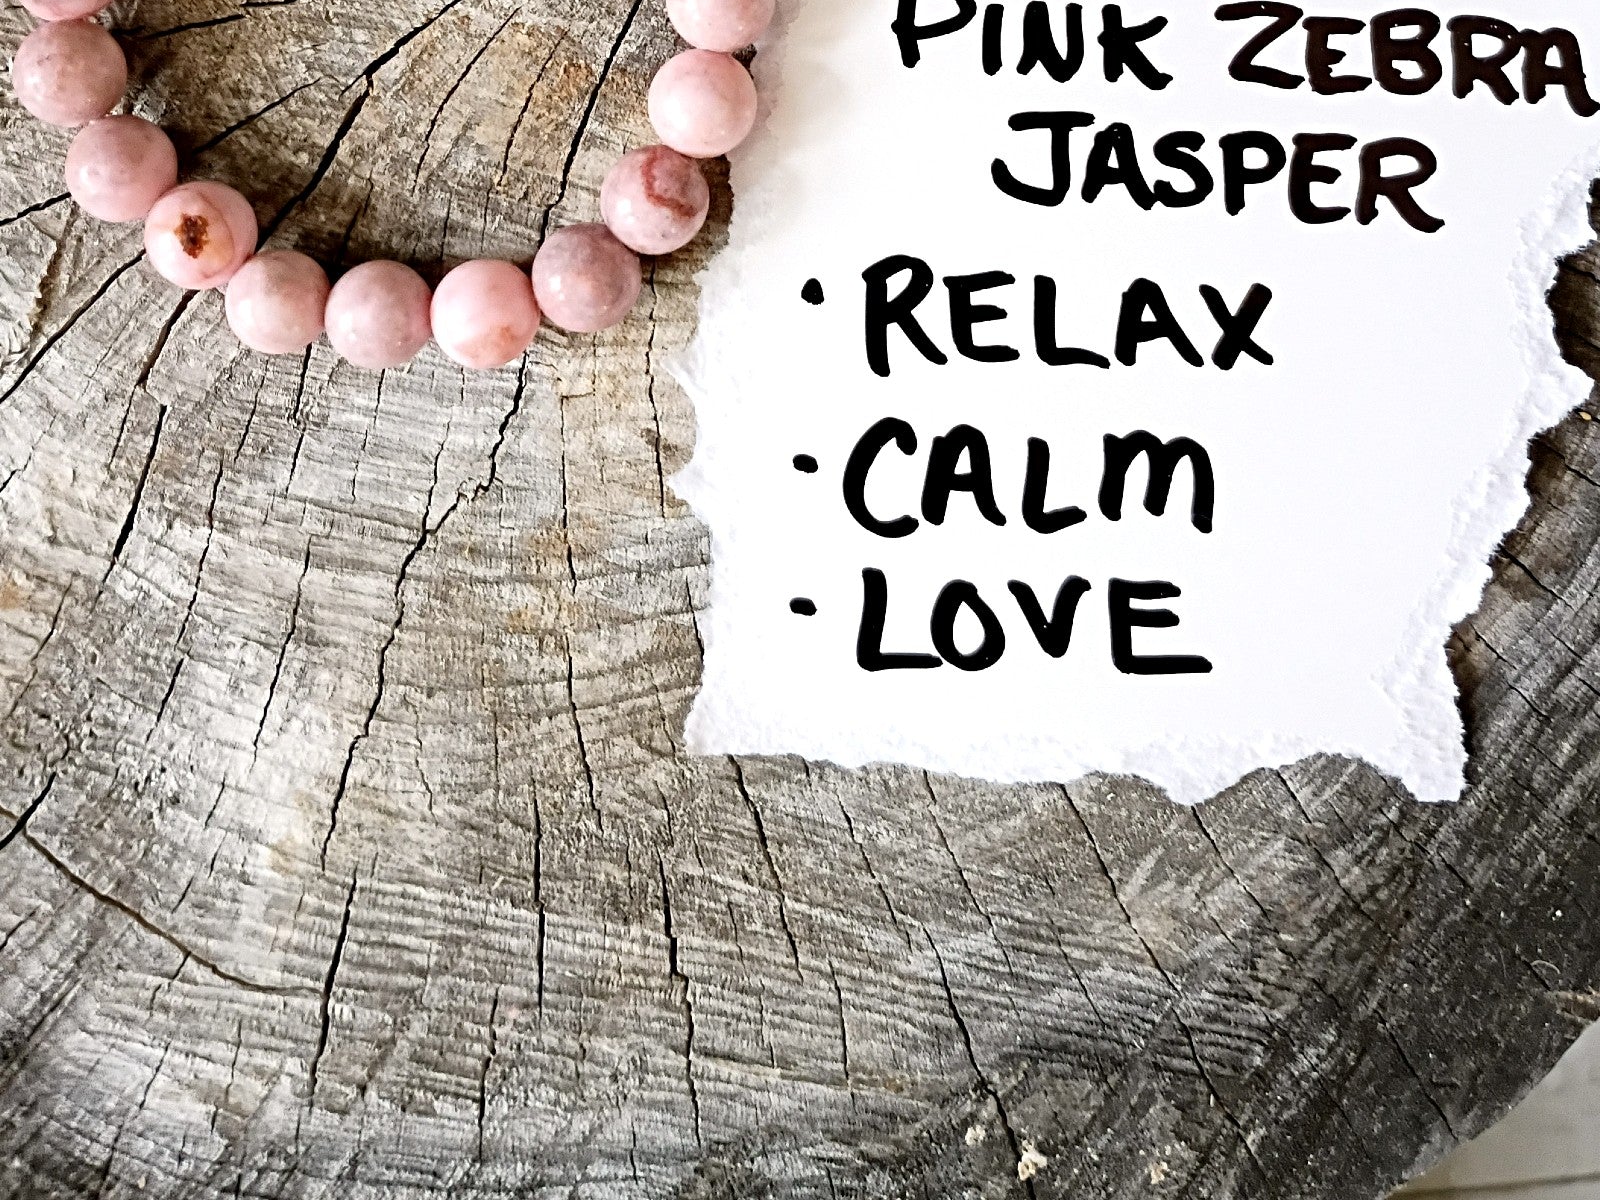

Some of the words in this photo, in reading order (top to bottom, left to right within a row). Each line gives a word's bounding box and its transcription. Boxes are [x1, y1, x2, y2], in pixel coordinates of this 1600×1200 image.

[1214, 0, 1600, 118] ZEBRA
[991, 110, 1446, 234] JASPER
[861, 254, 1274, 378] RELAX
[842, 416, 1215, 539] CALM
[856, 567, 1213, 676] LOVE
